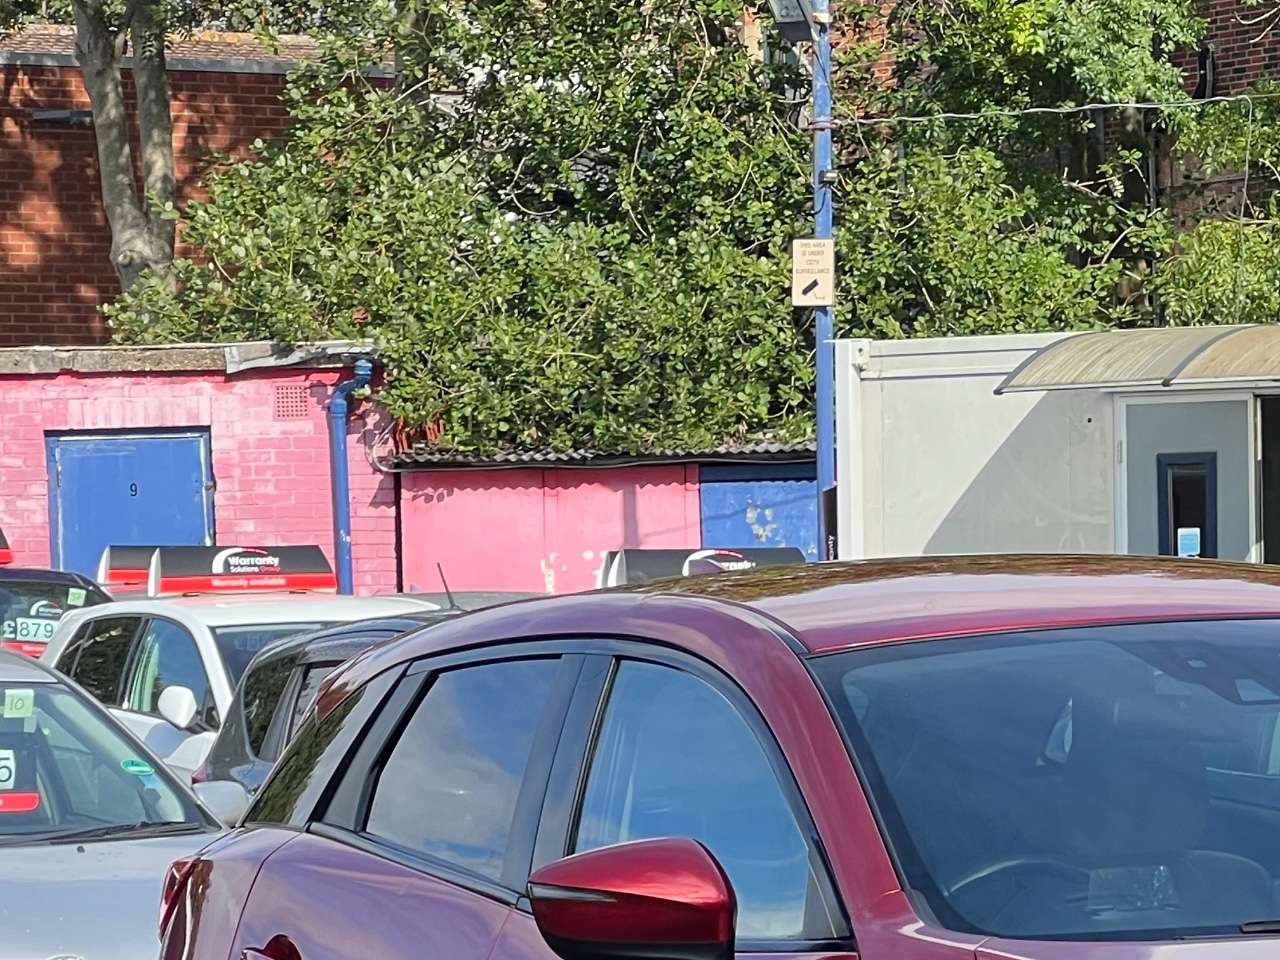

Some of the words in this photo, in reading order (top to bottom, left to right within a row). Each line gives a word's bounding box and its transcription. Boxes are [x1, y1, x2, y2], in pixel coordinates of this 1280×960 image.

[130, 483, 137, 496] 9
[227, 556, 280, 567] Warranty
[9, 693, 25, 711] 10
